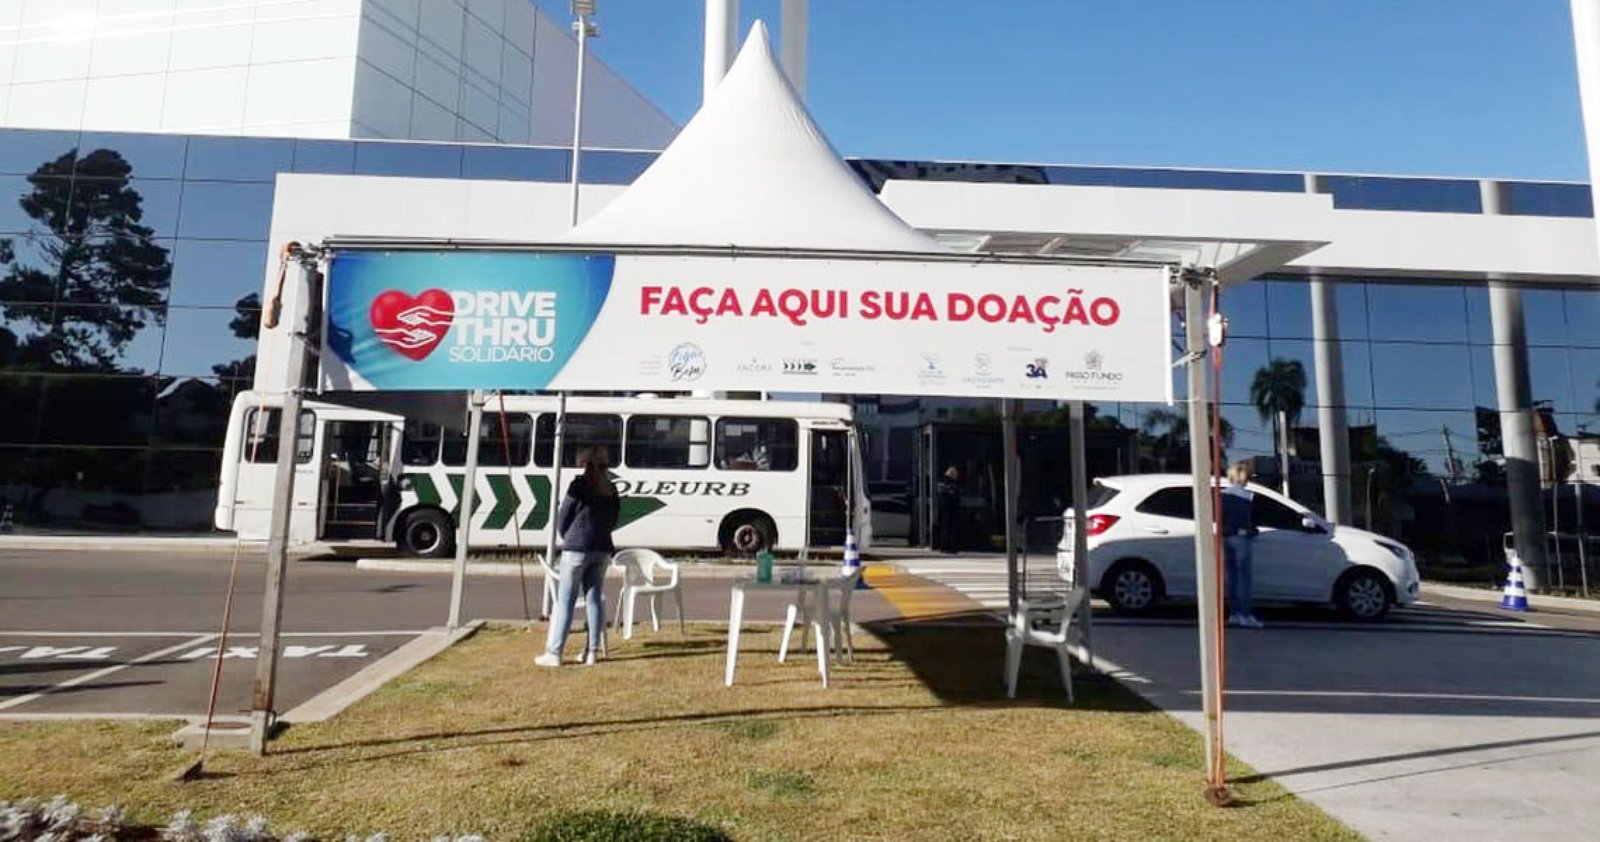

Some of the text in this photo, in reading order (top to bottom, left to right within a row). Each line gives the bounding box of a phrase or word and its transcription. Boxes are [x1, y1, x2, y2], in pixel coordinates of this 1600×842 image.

[453, 290, 556, 317] DRIVE
[641, 286, 1121, 333] FAÇA AQUI SUA DOAÇÃO
[453, 318, 556, 346] THRU
[1025, 363, 1048, 379] 3A
[1091, 372, 1123, 381] FUNDO
[611, 480, 751, 497] OLEURB
